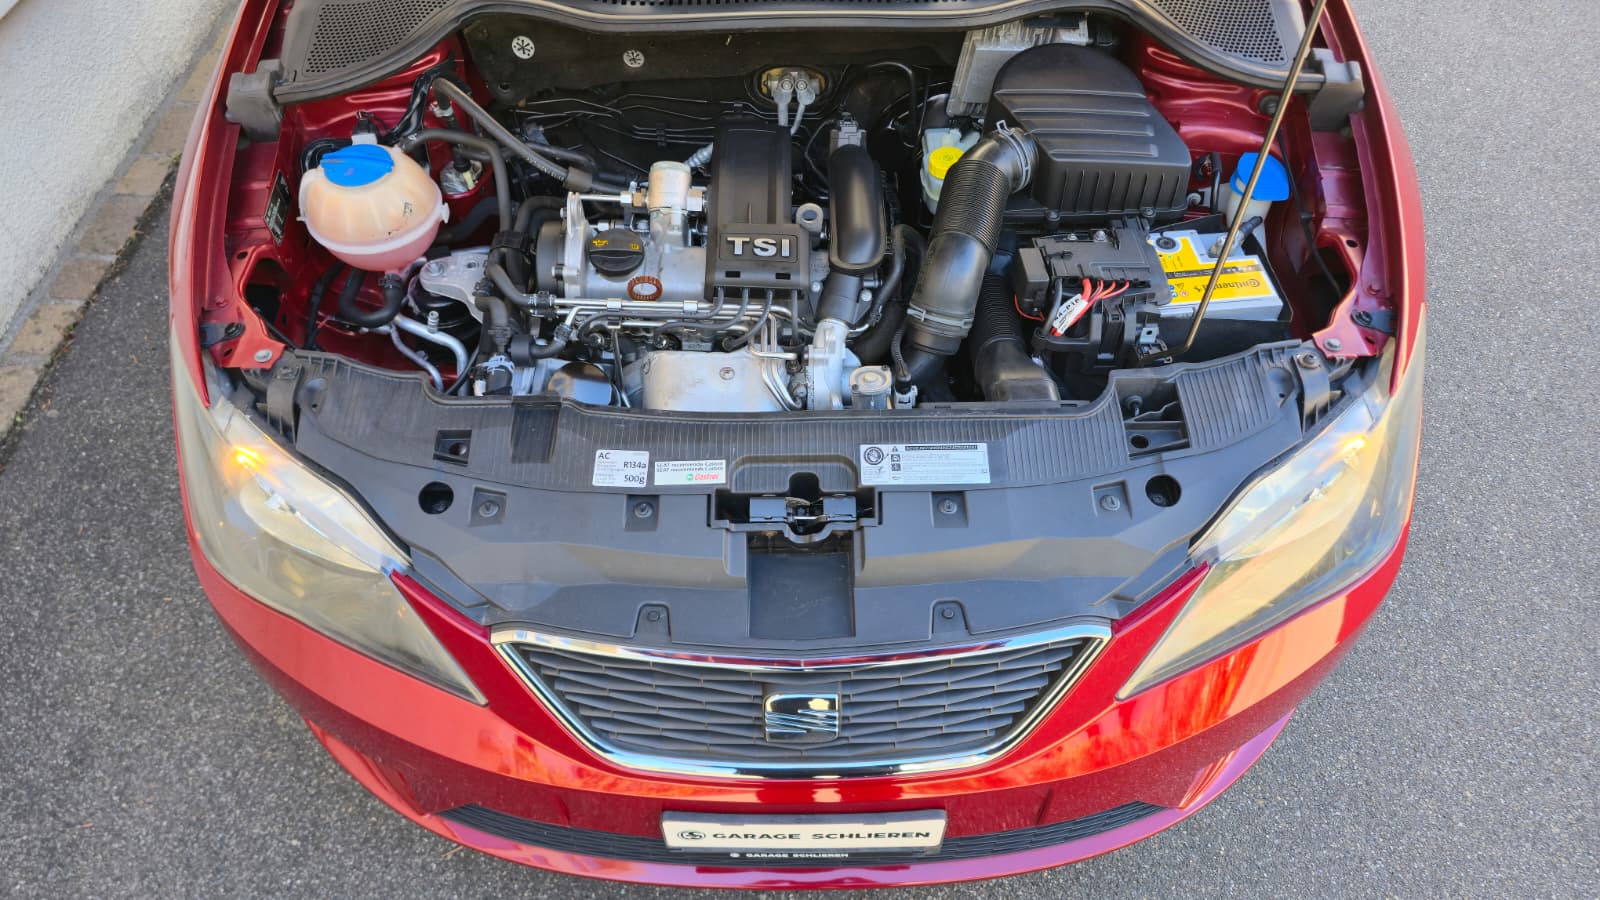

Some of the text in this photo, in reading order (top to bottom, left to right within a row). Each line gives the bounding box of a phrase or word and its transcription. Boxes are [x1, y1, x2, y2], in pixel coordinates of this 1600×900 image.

[726, 236, 791, 257] TSI
[623, 461, 647, 469] R134a
[624, 474, 645, 485] 500g
[712, 831, 931, 840] GARAGE SCHLIEREN
